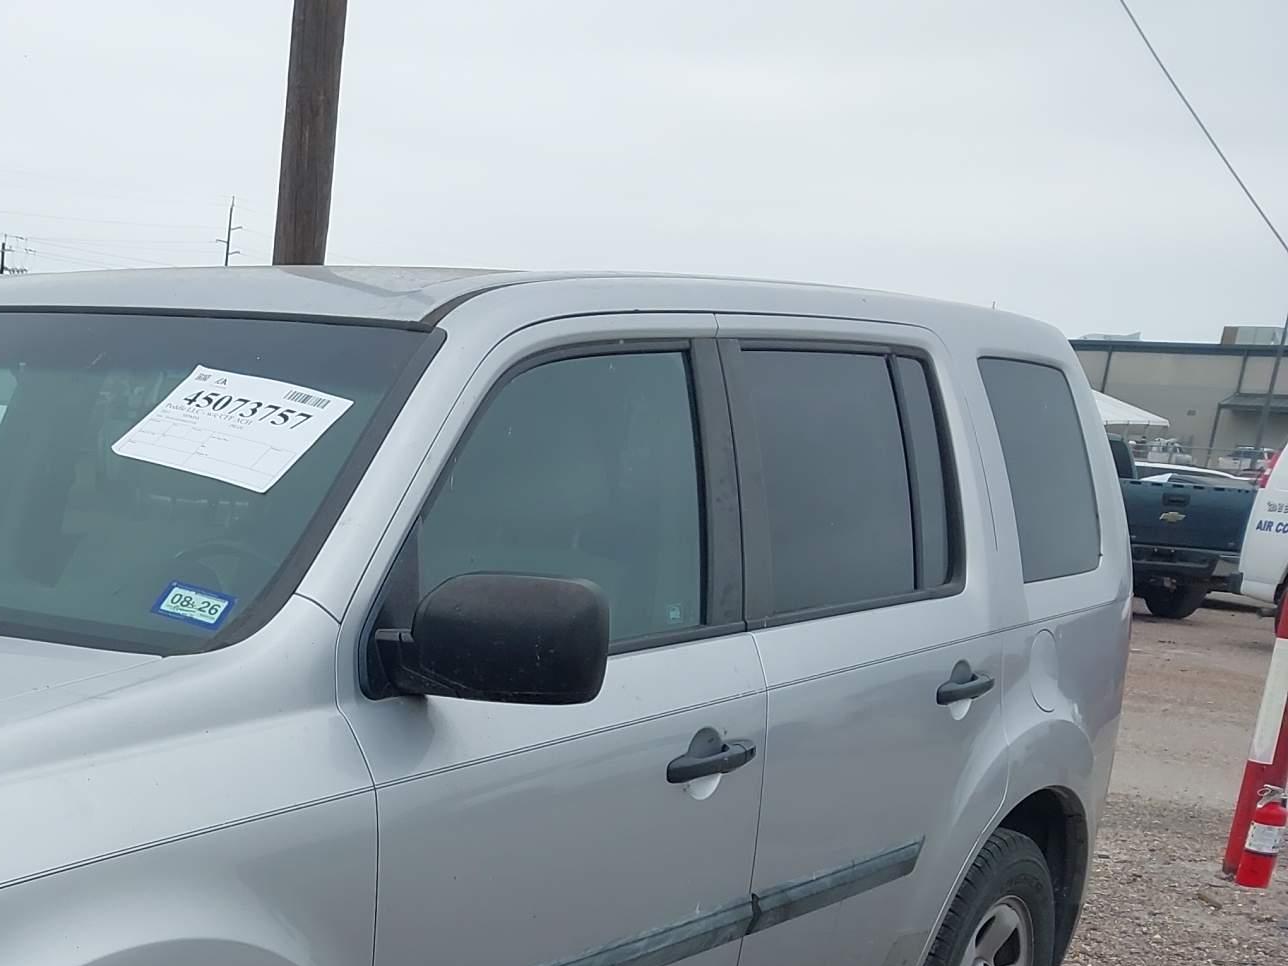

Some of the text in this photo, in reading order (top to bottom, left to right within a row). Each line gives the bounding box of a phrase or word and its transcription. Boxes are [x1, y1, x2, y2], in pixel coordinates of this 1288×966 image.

[184, 390, 313, 430] 45073757
[1256, 519, 1274, 532] AIR
[170, 593, 193, 608] 08
[197, 600, 221, 616] 26
